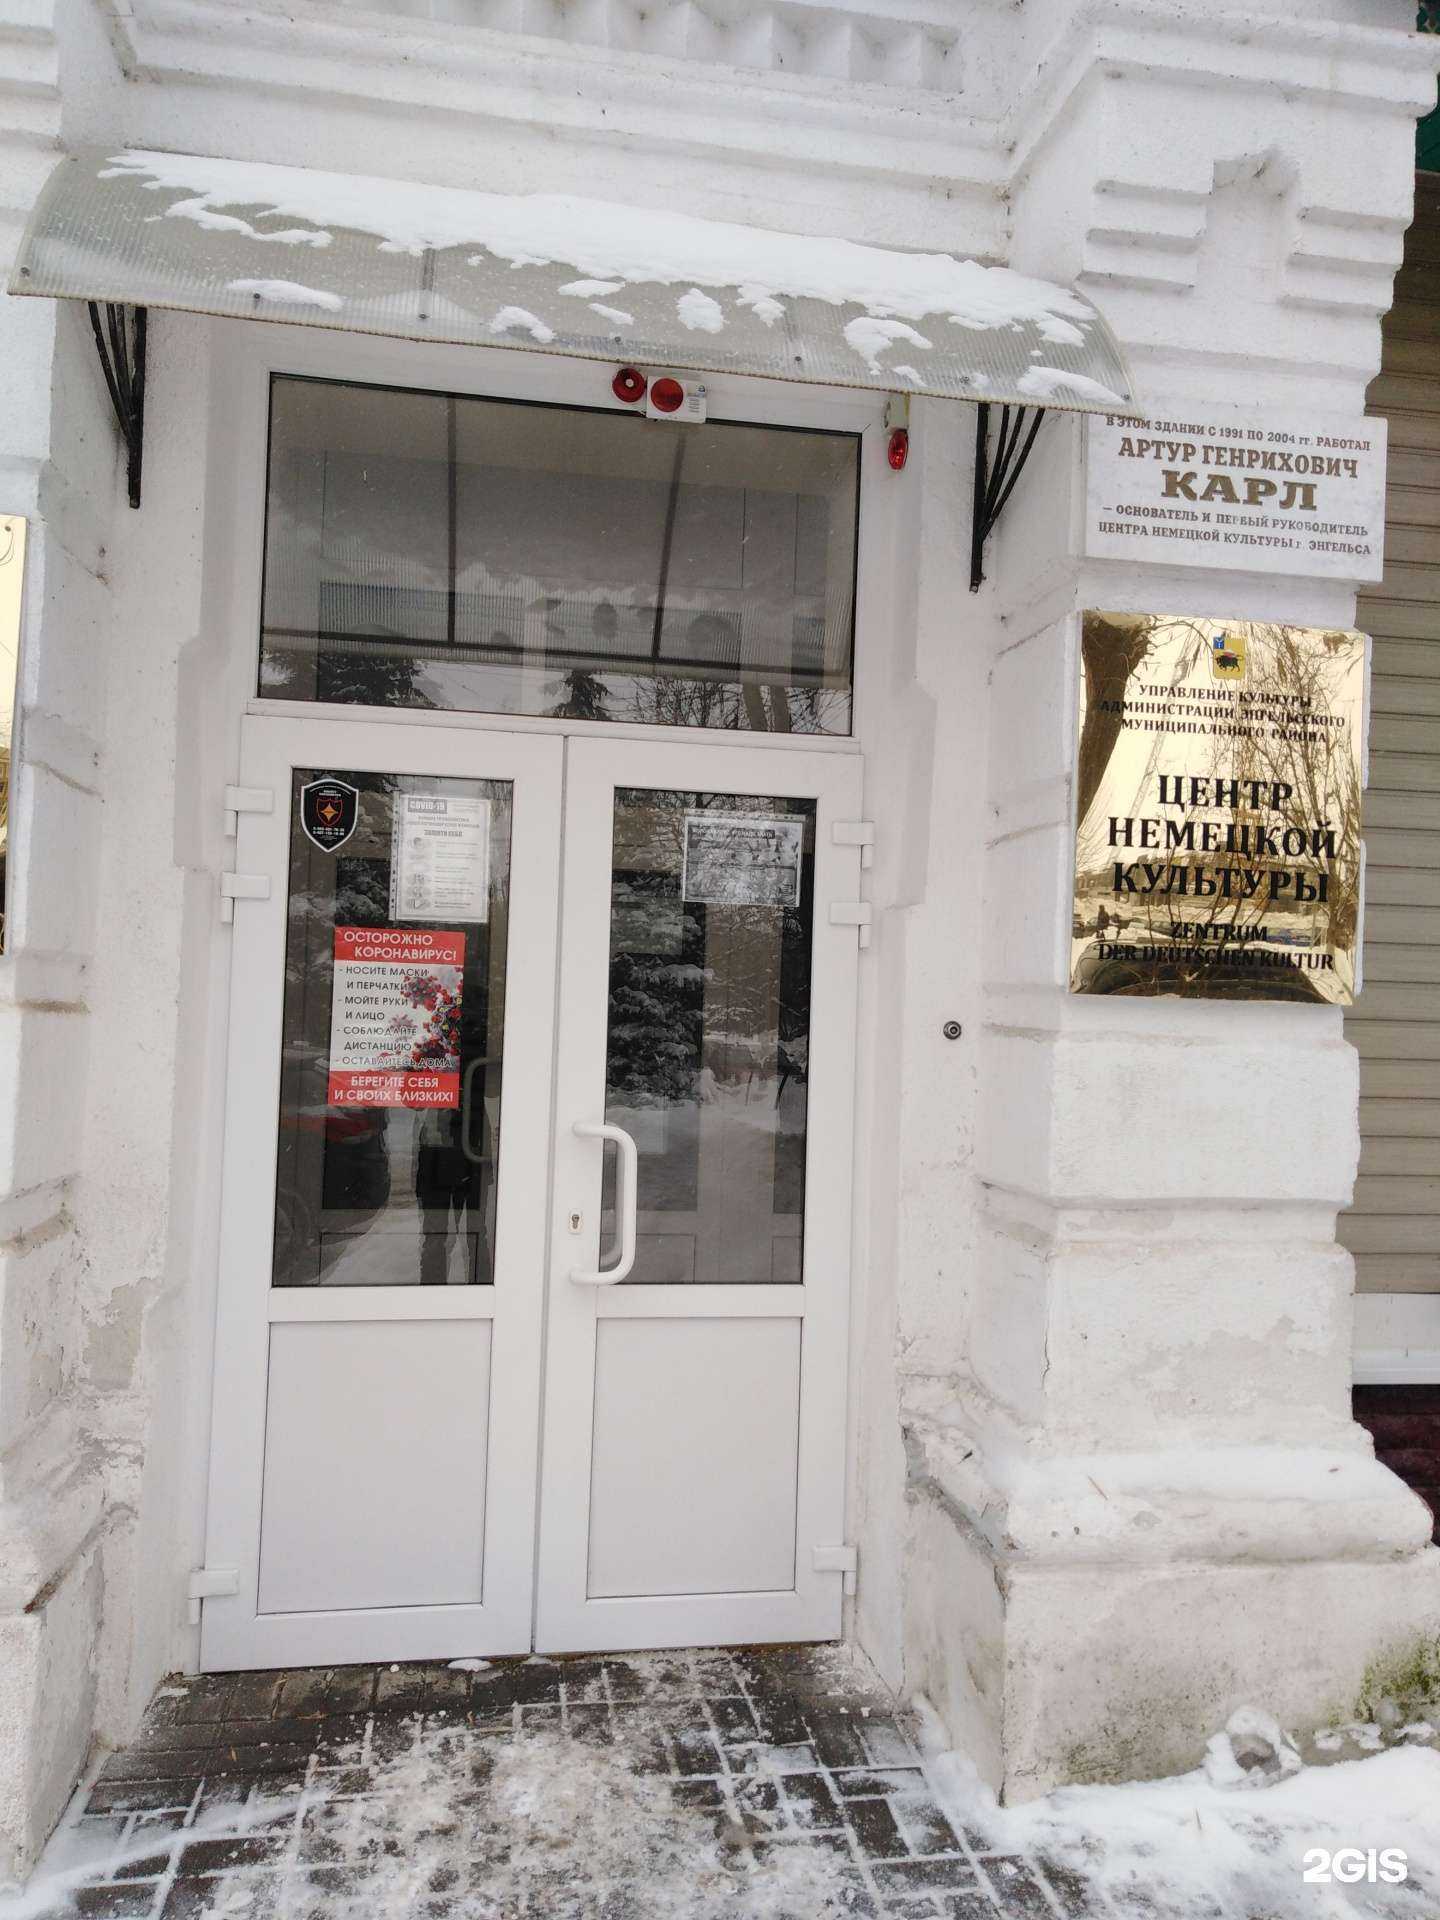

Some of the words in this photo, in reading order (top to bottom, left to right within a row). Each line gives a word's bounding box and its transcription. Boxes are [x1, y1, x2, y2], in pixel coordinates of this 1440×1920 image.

[1106, 417, 1114, 426] В
[1116, 416, 1151, 430] ЭТОМ
[1154, 421, 1205, 436] ЗДАНИИ
[1208, 426, 1216, 437] С
[1219, 427, 1243, 439] 1991
[1247, 430, 1263, 441] ПО
[1267, 431, 1295, 444] 2004
[1316, 436, 1371, 451] РАБОТАЛ
[1118, 437, 1197, 463] АРТУР
[1202, 444, 1358, 479] ГЕНРИХОВИЧ
[1161, 469, 1317, 511] КАРЛ
[1116, 504, 1199, 523] ОСНОВАТЕЛЬ
[1202, 512, 1211, 523] И
[1216, 513, 1269, 528] ПЕРВЫЙ
[1272, 518, 1368, 537] РУКОВОДИТЕЛЬ
[1099, 521, 1149, 536] ЦЕНТРА
[1152, 526, 1220, 543] НЕМЕЦКОЙ
[1223, 532, 1293, 549] КУЛЬТУРЫ
[1308, 540, 1371, 555] ЭНГЕЛЬСА
[1139, 684, 1234, 701] УПРАВЛЕНИЕ
[1239, 691, 1312, 708] КУЛЬТУРЫ
[1100, 701, 1234, 720] АДМИНИСТРАЦИИ
[1121, 718, 1264, 738] МУНИЦИПАЛЬНОГО
[1158, 775, 1293, 812] ЦЕНТР
[1107, 816, 1337, 860] НЕМЕЦКОЙ
[1112, 862, 1329, 903] КУЛЬТУРЫ
[344, 931, 433, 946] ОСТОРОЖНО
[1170, 922, 1268, 941] ZENTRUM
[354, 946, 457, 961] КОРОНАВИРУС!
[1098, 943, 1136, 961] DER
[1259, 950, 1334, 970] KULTUR
[346, 966, 386, 976] НОСИТЕ
[346, 982, 353, 990] И
[356, 981, 408, 991] ПЕРЧАТКИ
[344, 996, 379, 1006] МОЙТЕ
[382, 997, 408, 1006] РУКИ
[345, 1011, 353, 1019] И
[355, 1012, 385, 1021] ЛИЦО
[343, 1026, 416, 1036] СОБЛЮДАЙТЕ
[344, 1042, 411, 1051] ДИСТАНЦИЮ
[351, 1076, 404, 1087] БЕРЕГИТЕ
[408, 1077, 438, 1088] СЕБЯ
[334, 1090, 343, 1100] И
[346, 1090, 391, 1101] СВОИХ
[395, 1091, 453, 1102] БЛИЗКИХ!
